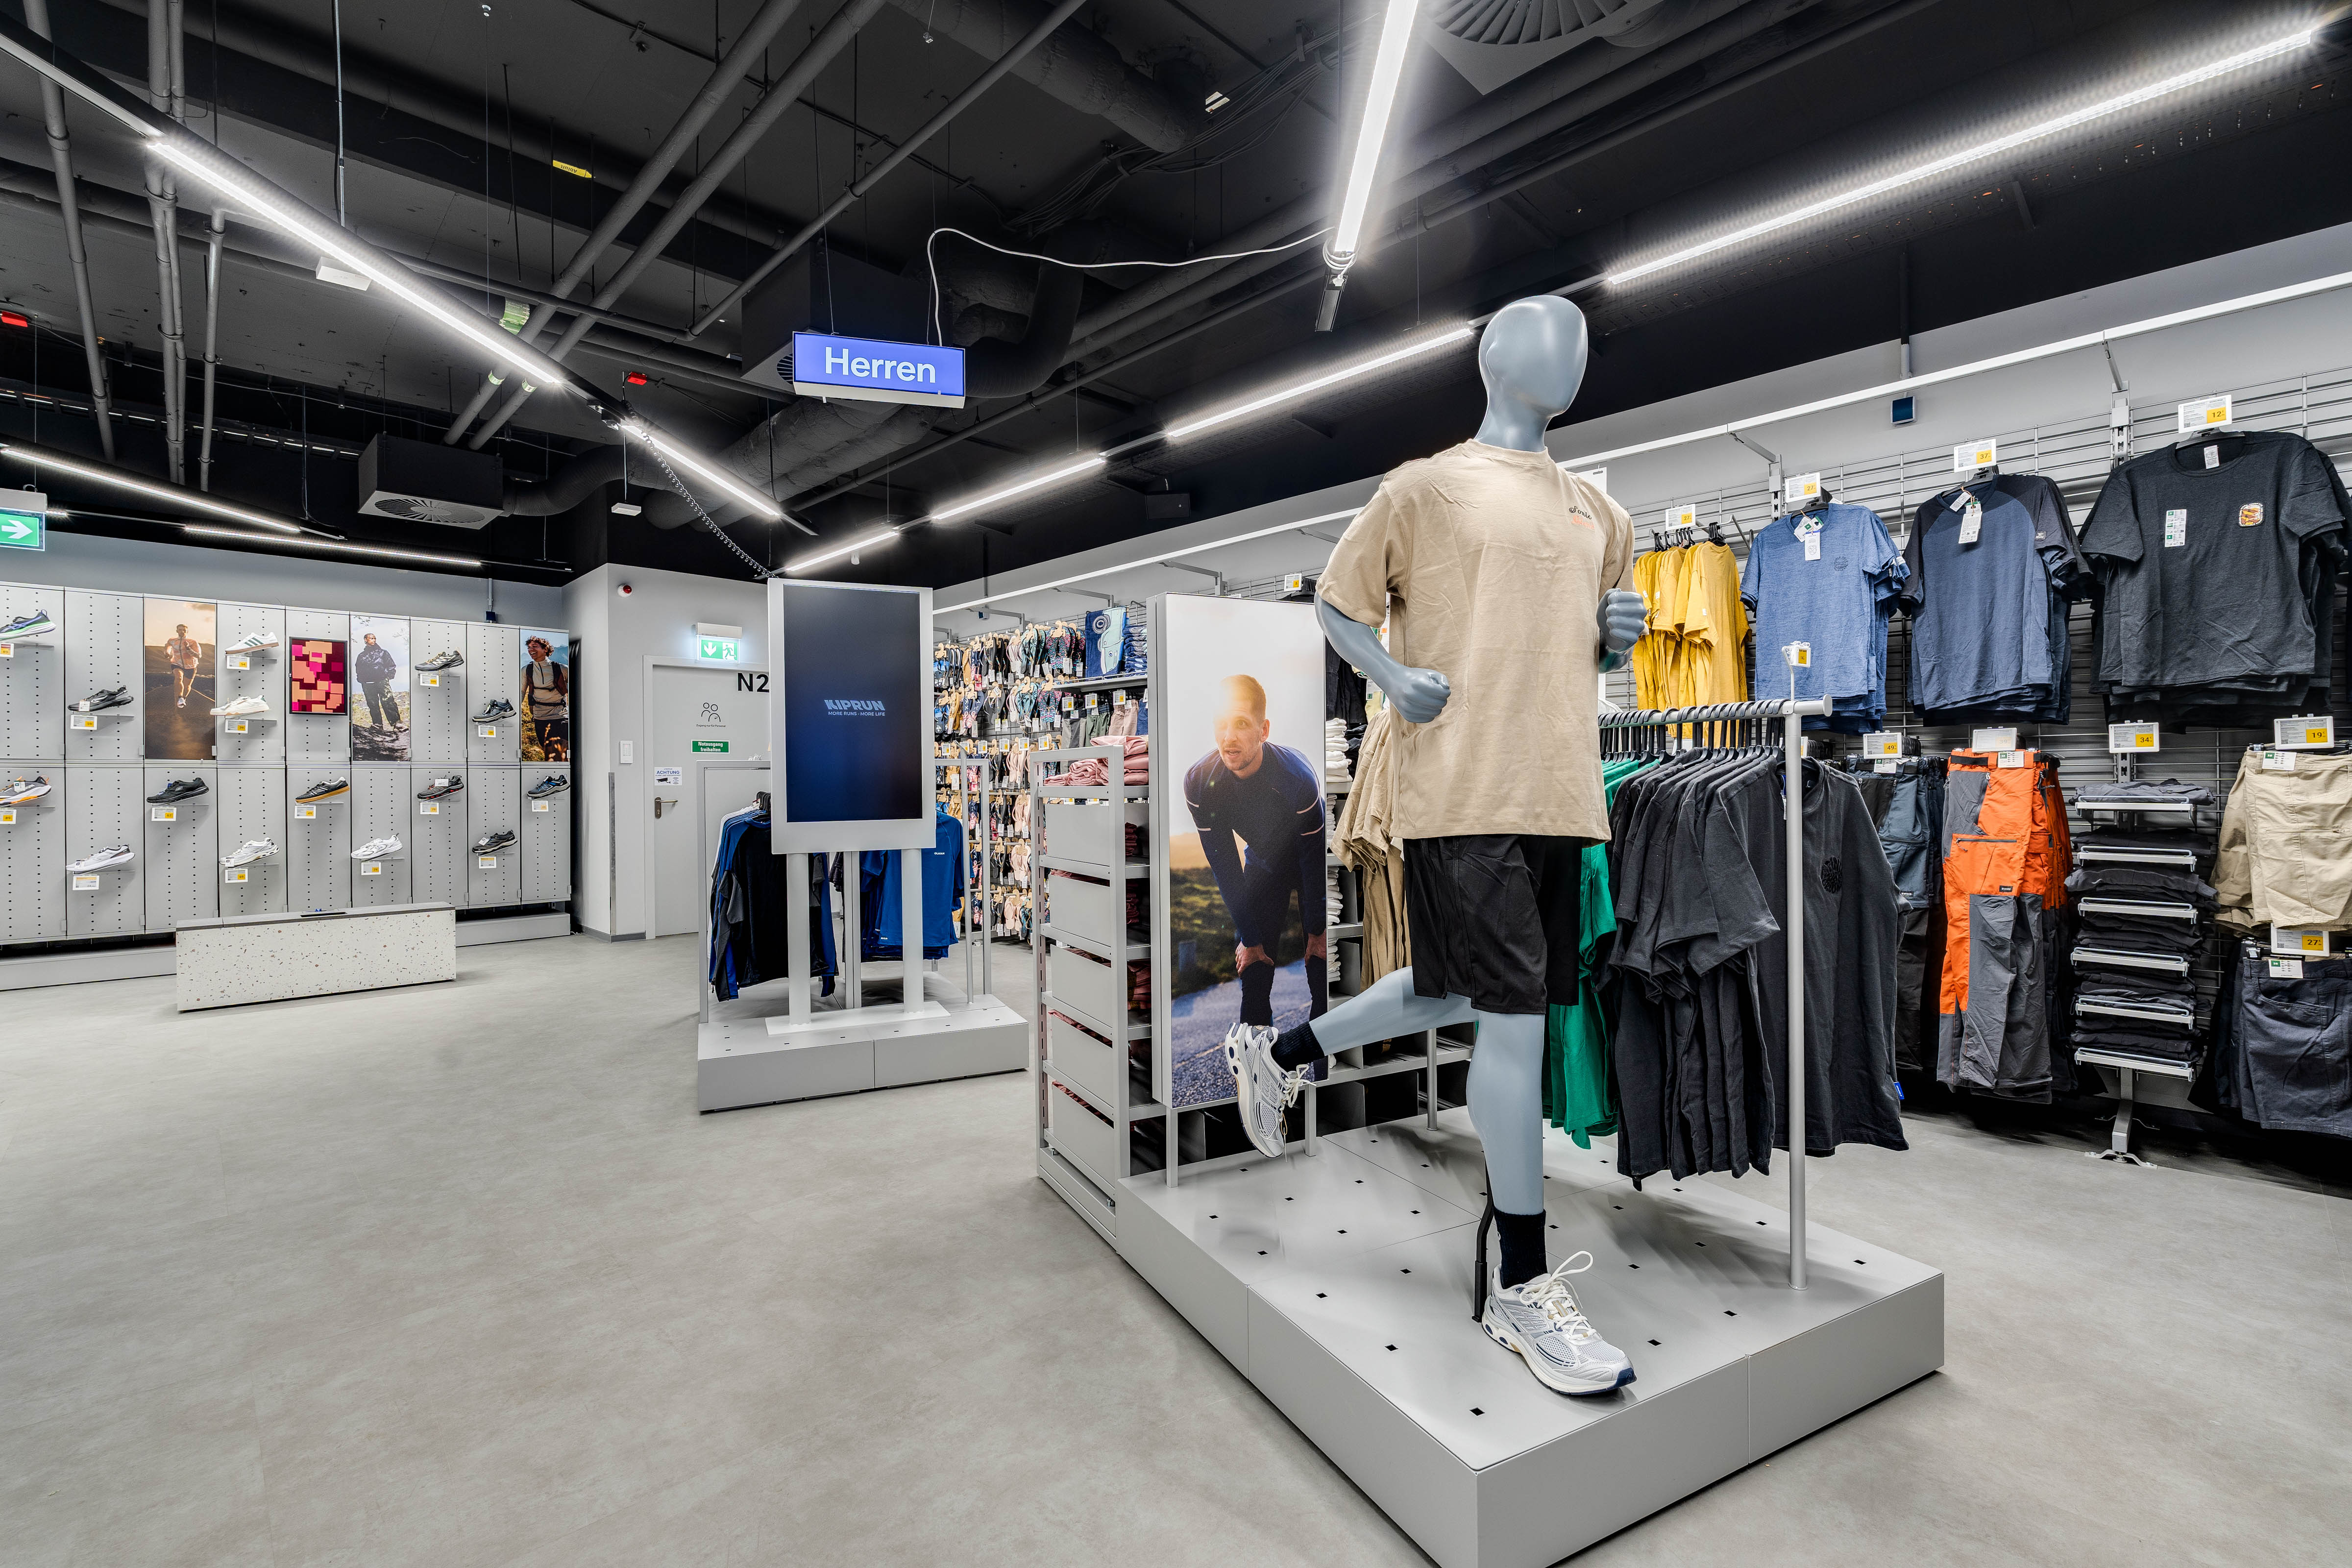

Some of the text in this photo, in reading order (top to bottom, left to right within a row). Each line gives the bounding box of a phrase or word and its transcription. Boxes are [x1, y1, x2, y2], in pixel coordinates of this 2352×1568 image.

[825, 346, 936, 383] Herren
[737, 673, 769, 693] N2
[824, 700, 885, 710] KIPRUN
